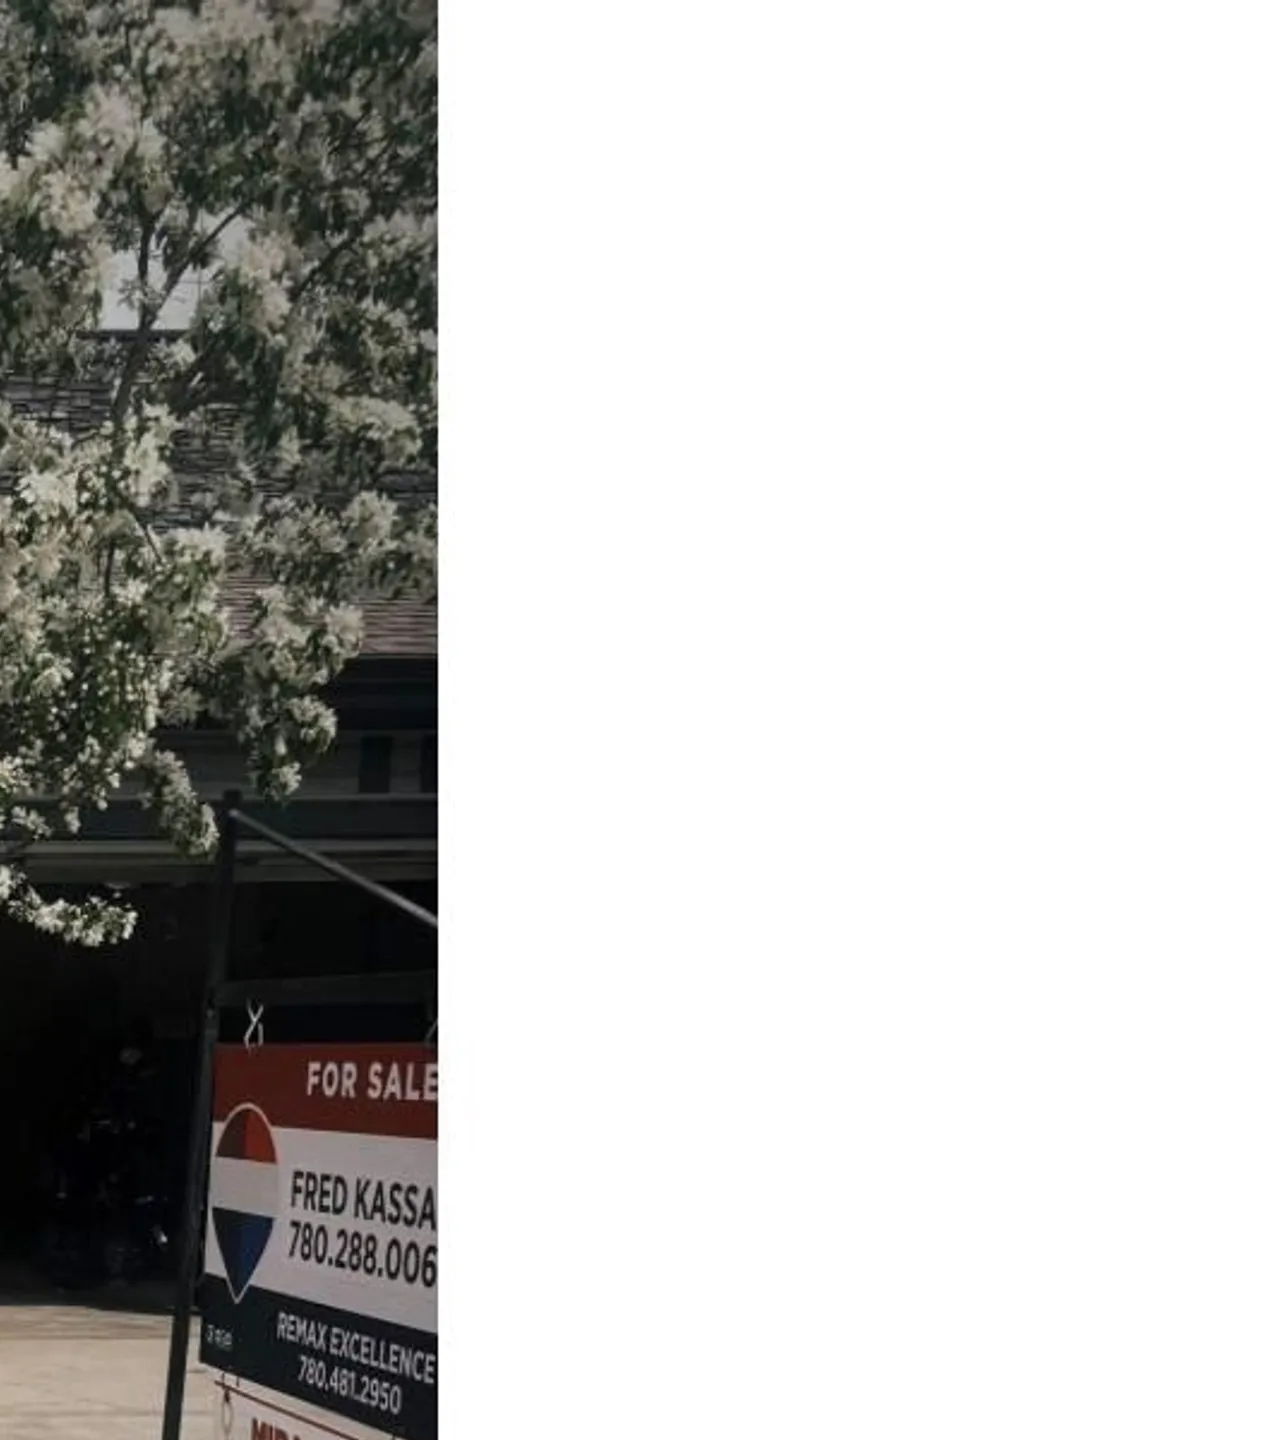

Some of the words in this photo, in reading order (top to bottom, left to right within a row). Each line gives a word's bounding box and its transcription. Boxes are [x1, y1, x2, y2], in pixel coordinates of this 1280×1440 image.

[306, 1060, 358, 1098] FOR
[367, 1060, 438, 1101] SALE
[290, 1169, 348, 1216] FRED
[353, 1177, 437, 1232] KASSA
[288, 1219, 438, 1288] 780.288.006
[276, 1310, 328, 1352] REMAX
[329, 1327, 437, 1385] EXCELLENCE
[297, 1354, 403, 1416] 780.481.2950
